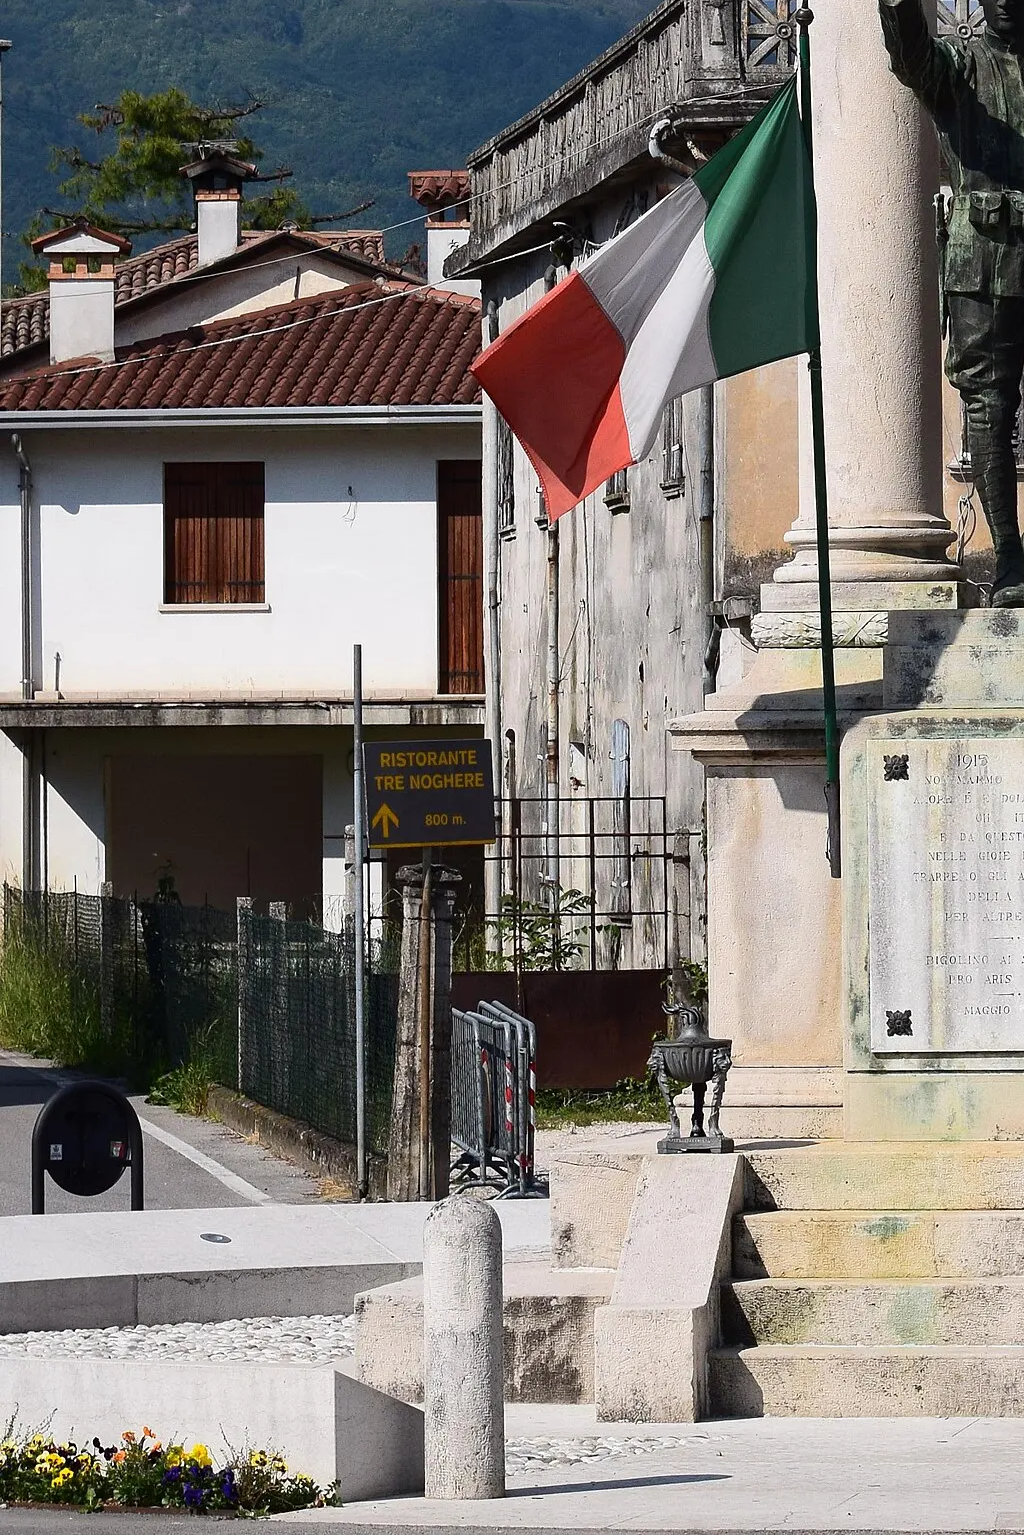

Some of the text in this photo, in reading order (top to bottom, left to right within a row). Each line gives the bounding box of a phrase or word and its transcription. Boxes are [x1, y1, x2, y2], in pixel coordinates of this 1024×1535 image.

[380, 750, 477, 768] RISTORANTE
[957, 754, 988, 770] 1915
[374, 773, 484, 790] TRE NOGHERE
[914, 795, 952, 804] AORE
[425, 814, 466, 826] 800 m.
[960, 832, 974, 842] DA
[928, 852, 966, 861] NELLE
[978, 851, 1011, 860] GIOIE
[913, 872, 976, 881] TRARREO
[988, 872, 1007, 881] GLI
[945, 912, 970, 922] PER
[983, 912, 1022, 922] ALTRE
[926, 956, 989, 965] BIGOLINO
[1000, 955, 1011, 964] AI
[948, 974, 972, 984] PRO
[984, 974, 1012, 984] ARIS
[964, 1006, 1010, 1015] MAGGIO
